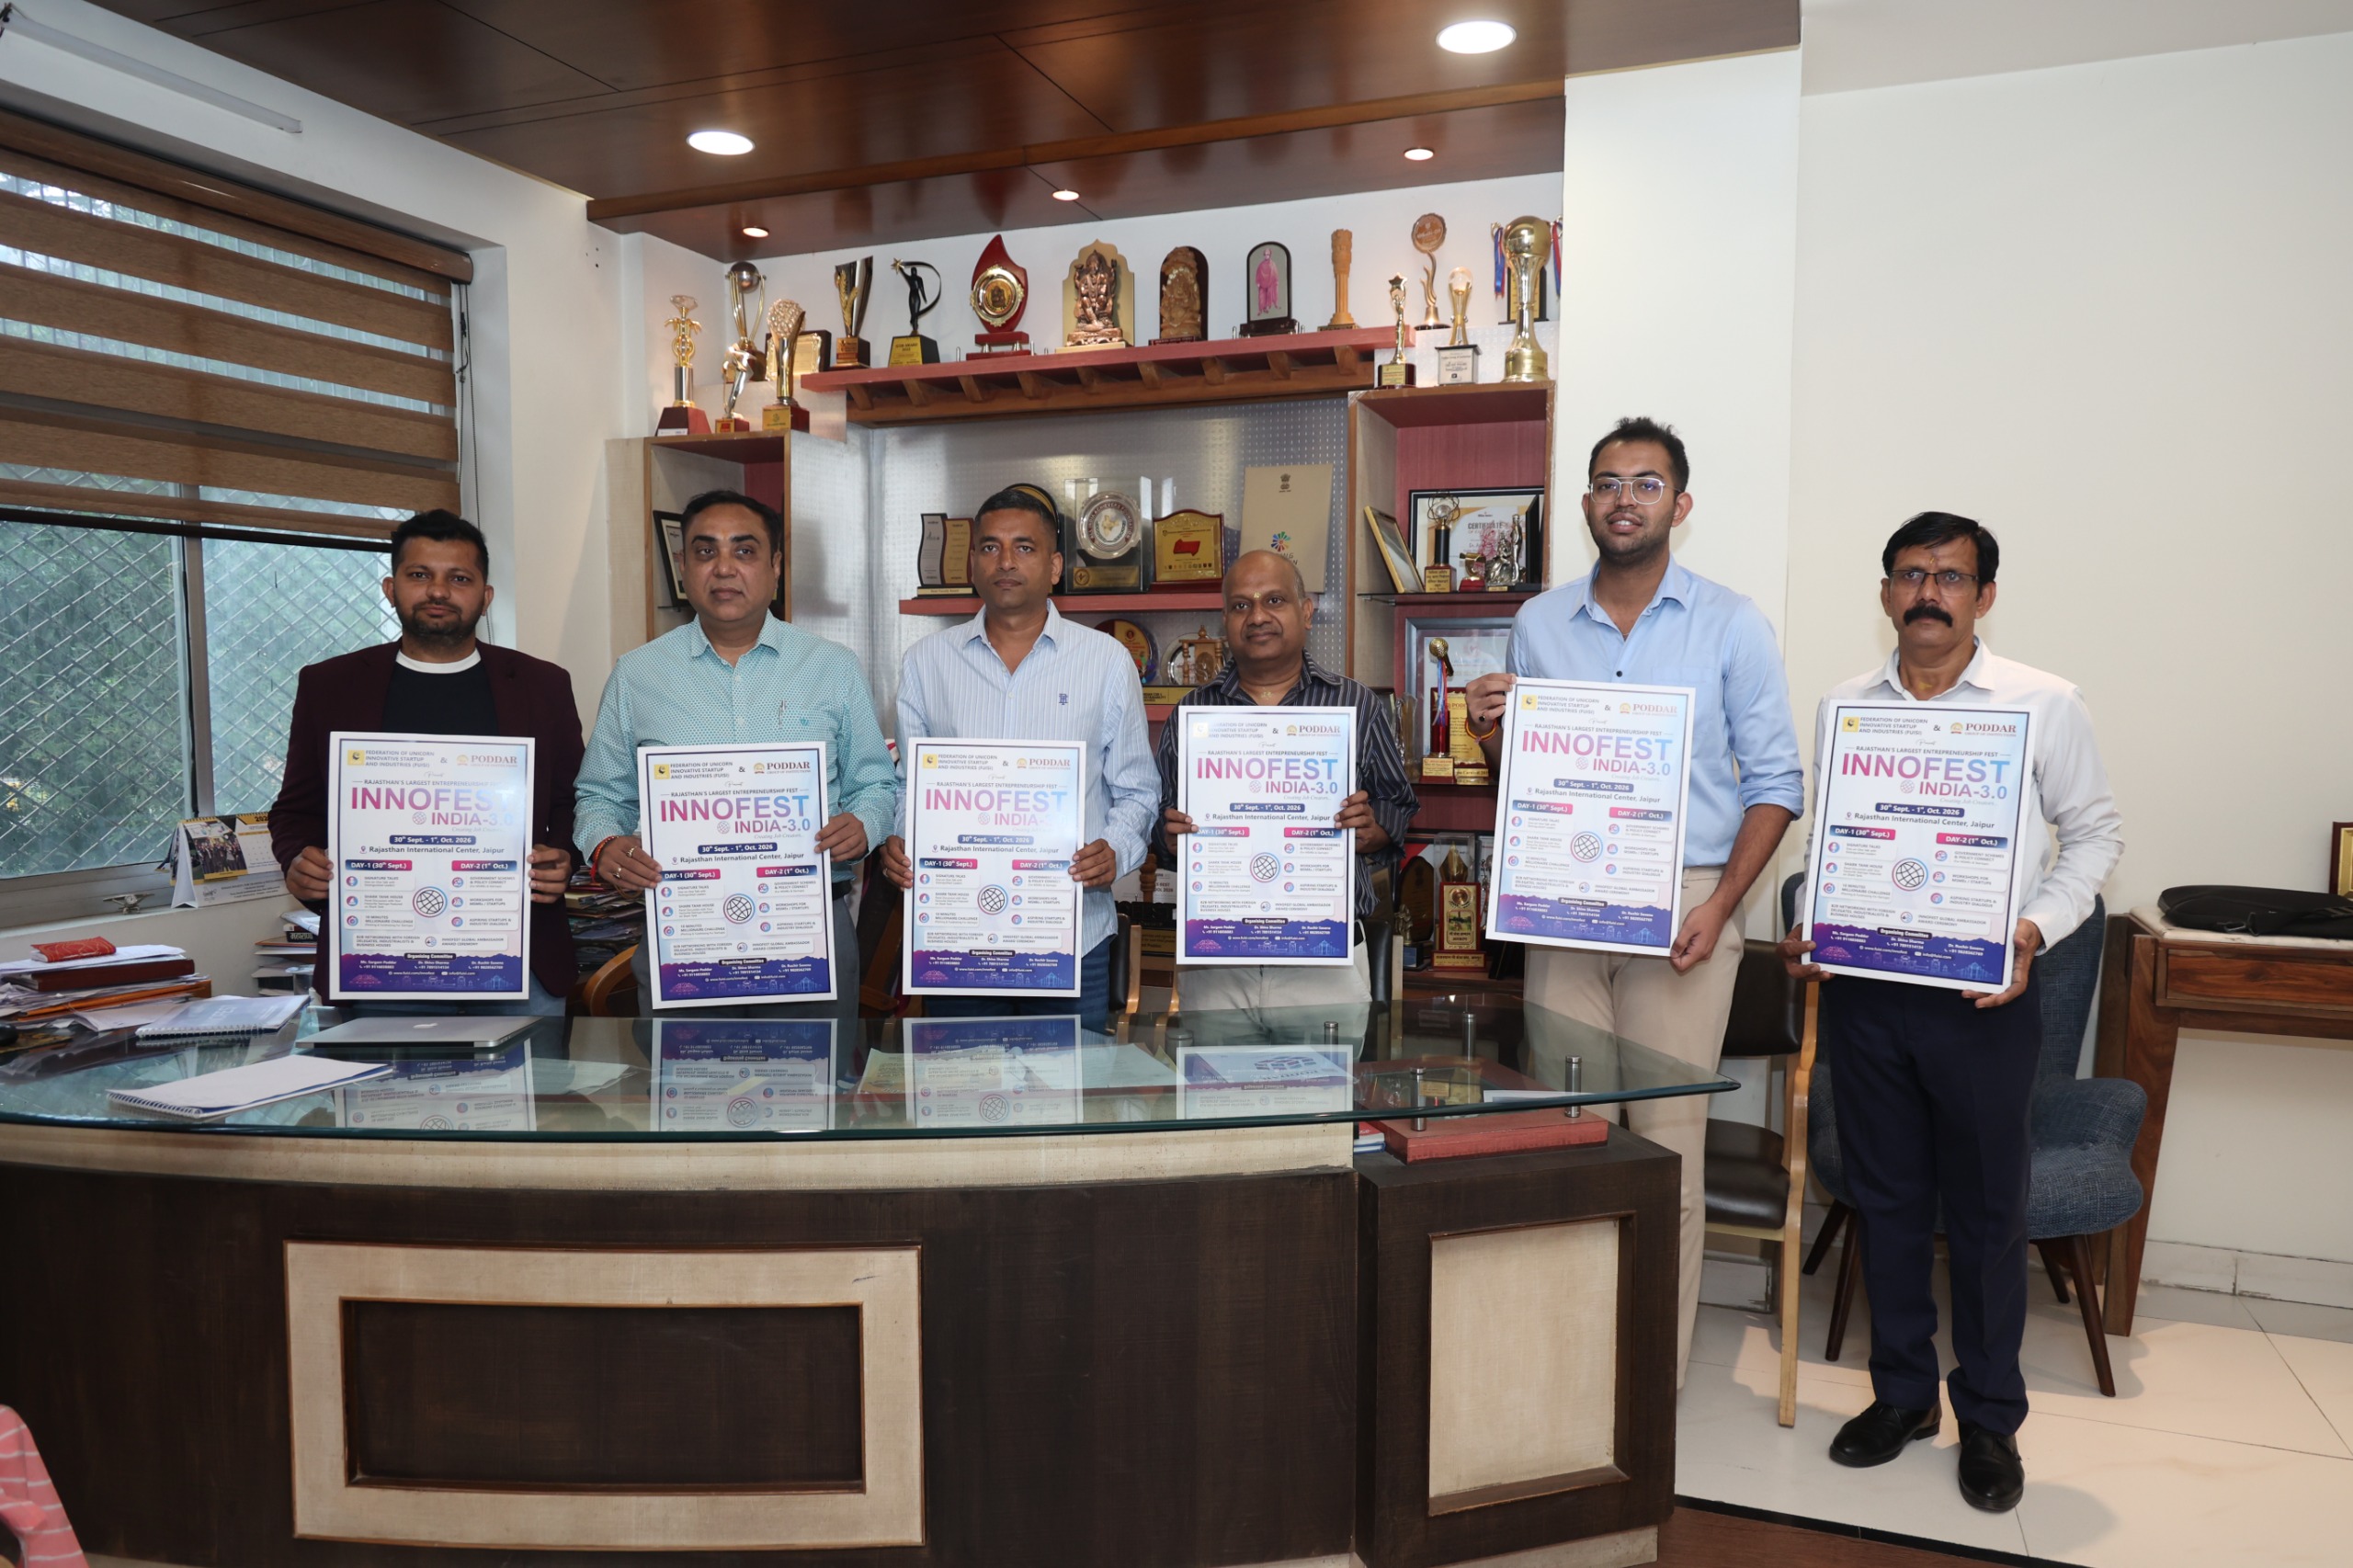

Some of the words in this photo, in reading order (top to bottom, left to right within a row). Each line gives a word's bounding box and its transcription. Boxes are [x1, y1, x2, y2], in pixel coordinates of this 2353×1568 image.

[1633, 704, 1677, 713] PODDAR
[1965, 723, 2017, 733] PODDAR
[1522, 731, 1673, 761] INNOFEST
[471, 755, 517, 763] PODDAR
[767, 762, 810, 770] PODDAR
[1198, 757, 1337, 779] INNOFEST
[1593, 758, 1671, 776] INDIA-3.0
[1842, 753, 2010, 784] INNOFEST
[1266, 781, 1337, 793] INDIA-3.0
[1919, 781, 2007, 800] INDIA-3.0
[352, 787, 514, 812] INNOFEST
[926, 790, 1067, 812] INNOFEST
[1534, 789, 1567, 797] Rajasthan
[1569, 790, 1612, 799] International
[1614, 794, 1637, 802] Center,
[1639, 796, 1660, 804] Jaipur
[661, 795, 810, 822] INNOFEST
[1550, 805, 1568, 813] Sept.)
[735, 819, 811, 834] INDIA-3.0
[1854, 812, 1890, 823] Rajasthan
[1892, 815, 1939, 824] International
[1942, 819, 1969, 827] Center,
[1971, 821, 1995, 830] Jaipur
[1870, 831, 1890, 839] Sept.)
[1981, 838, 1998, 846] Oct.)
